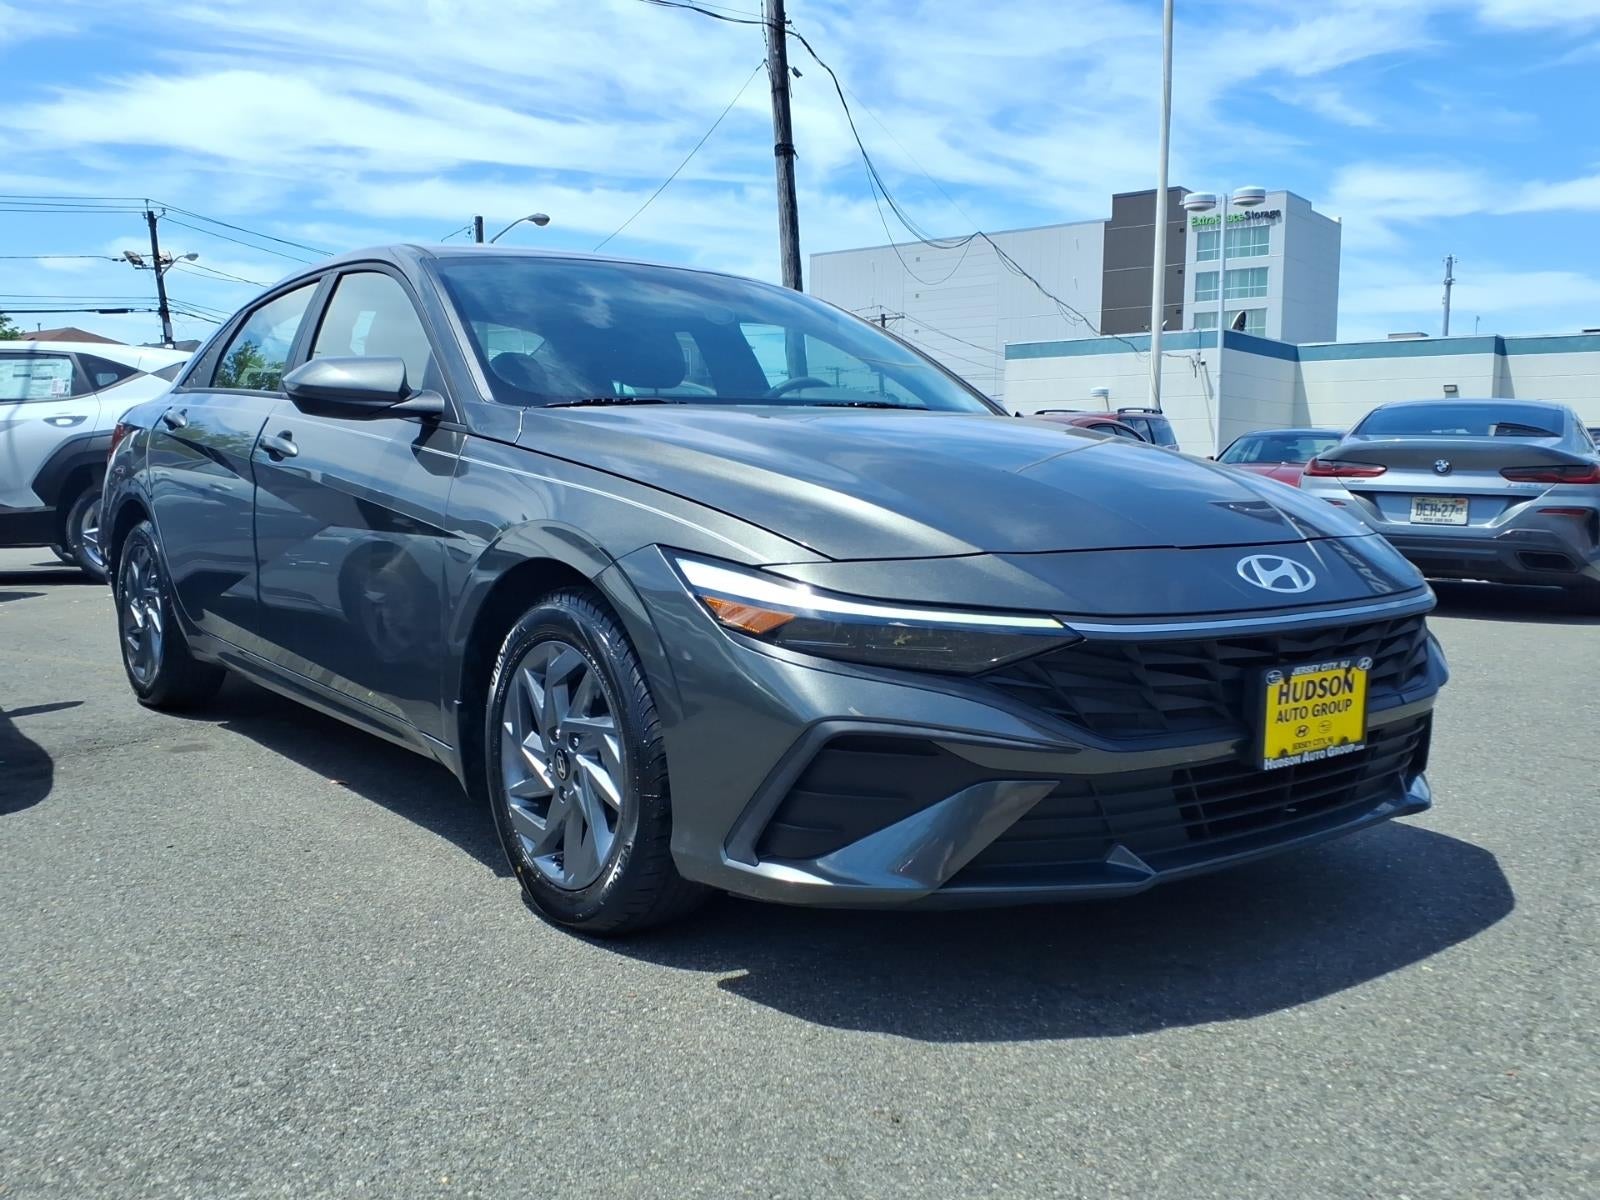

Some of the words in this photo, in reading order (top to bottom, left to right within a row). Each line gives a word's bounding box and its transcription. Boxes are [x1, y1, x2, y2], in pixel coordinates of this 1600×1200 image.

[1191, 213, 1244, 226] ExtraSace
[1278, 674, 1354, 705] HUDSON
[1275, 705, 1309, 724] AUTO
[1311, 698, 1353, 717] GROUP
